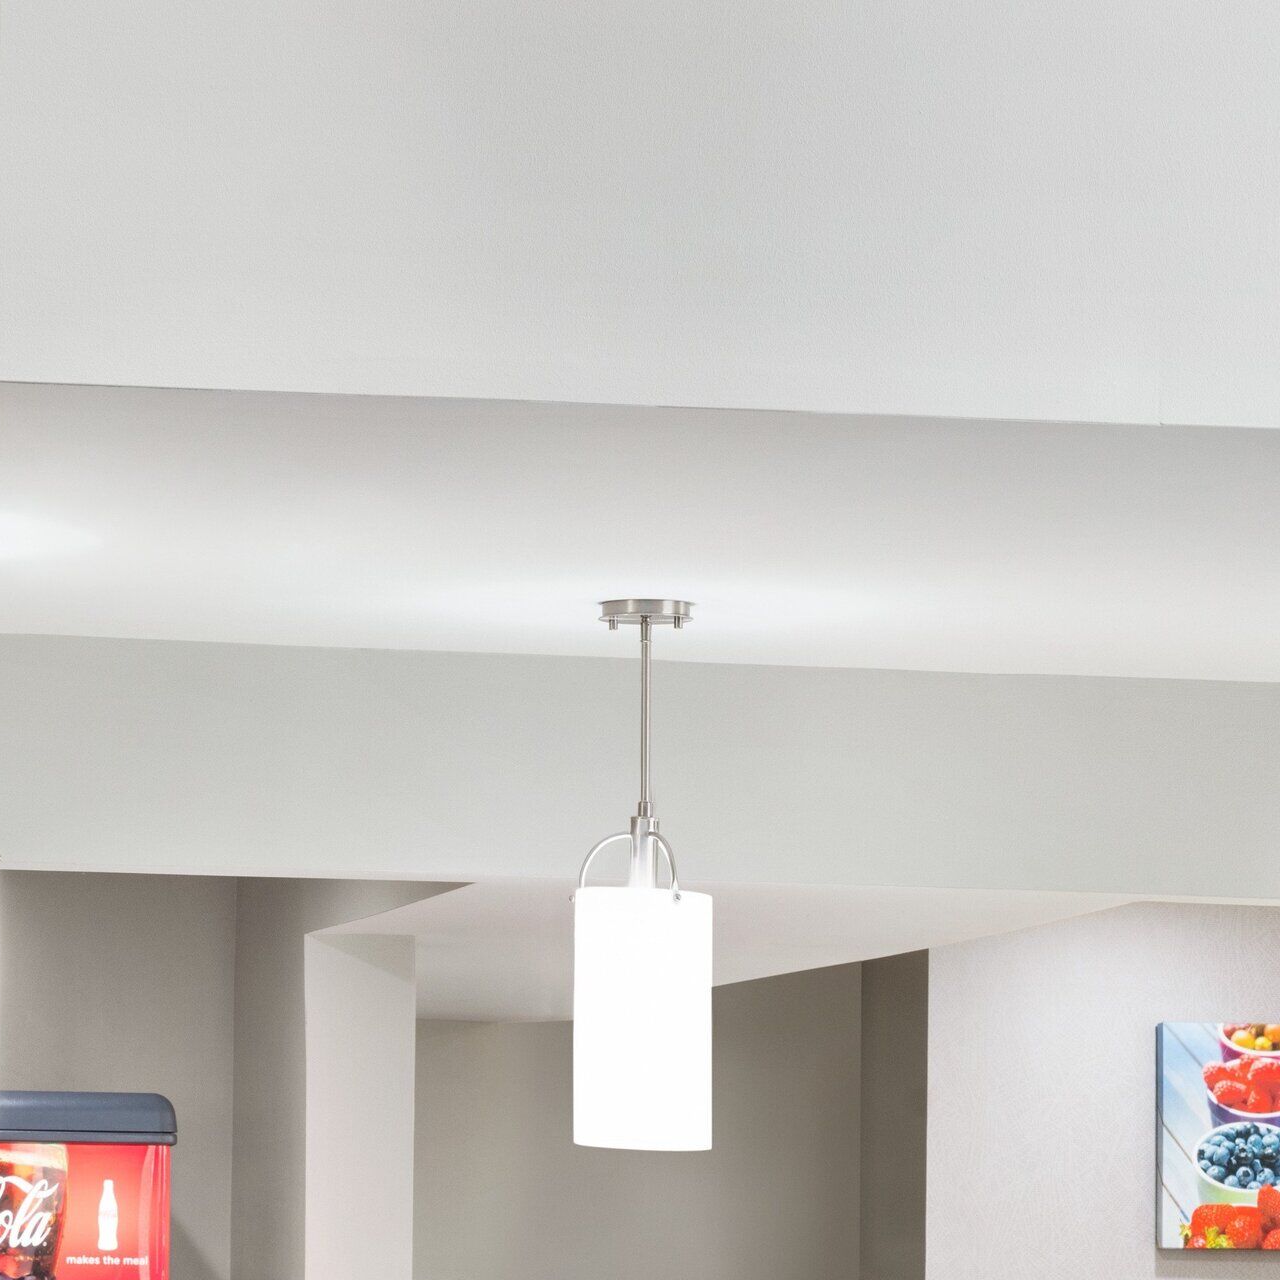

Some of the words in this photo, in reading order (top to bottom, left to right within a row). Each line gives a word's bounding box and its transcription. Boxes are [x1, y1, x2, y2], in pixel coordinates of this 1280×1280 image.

[66, 1256, 101, 1265] makes
[103, 1256, 120, 1265] the
[123, 1256, 148, 1265] meal
